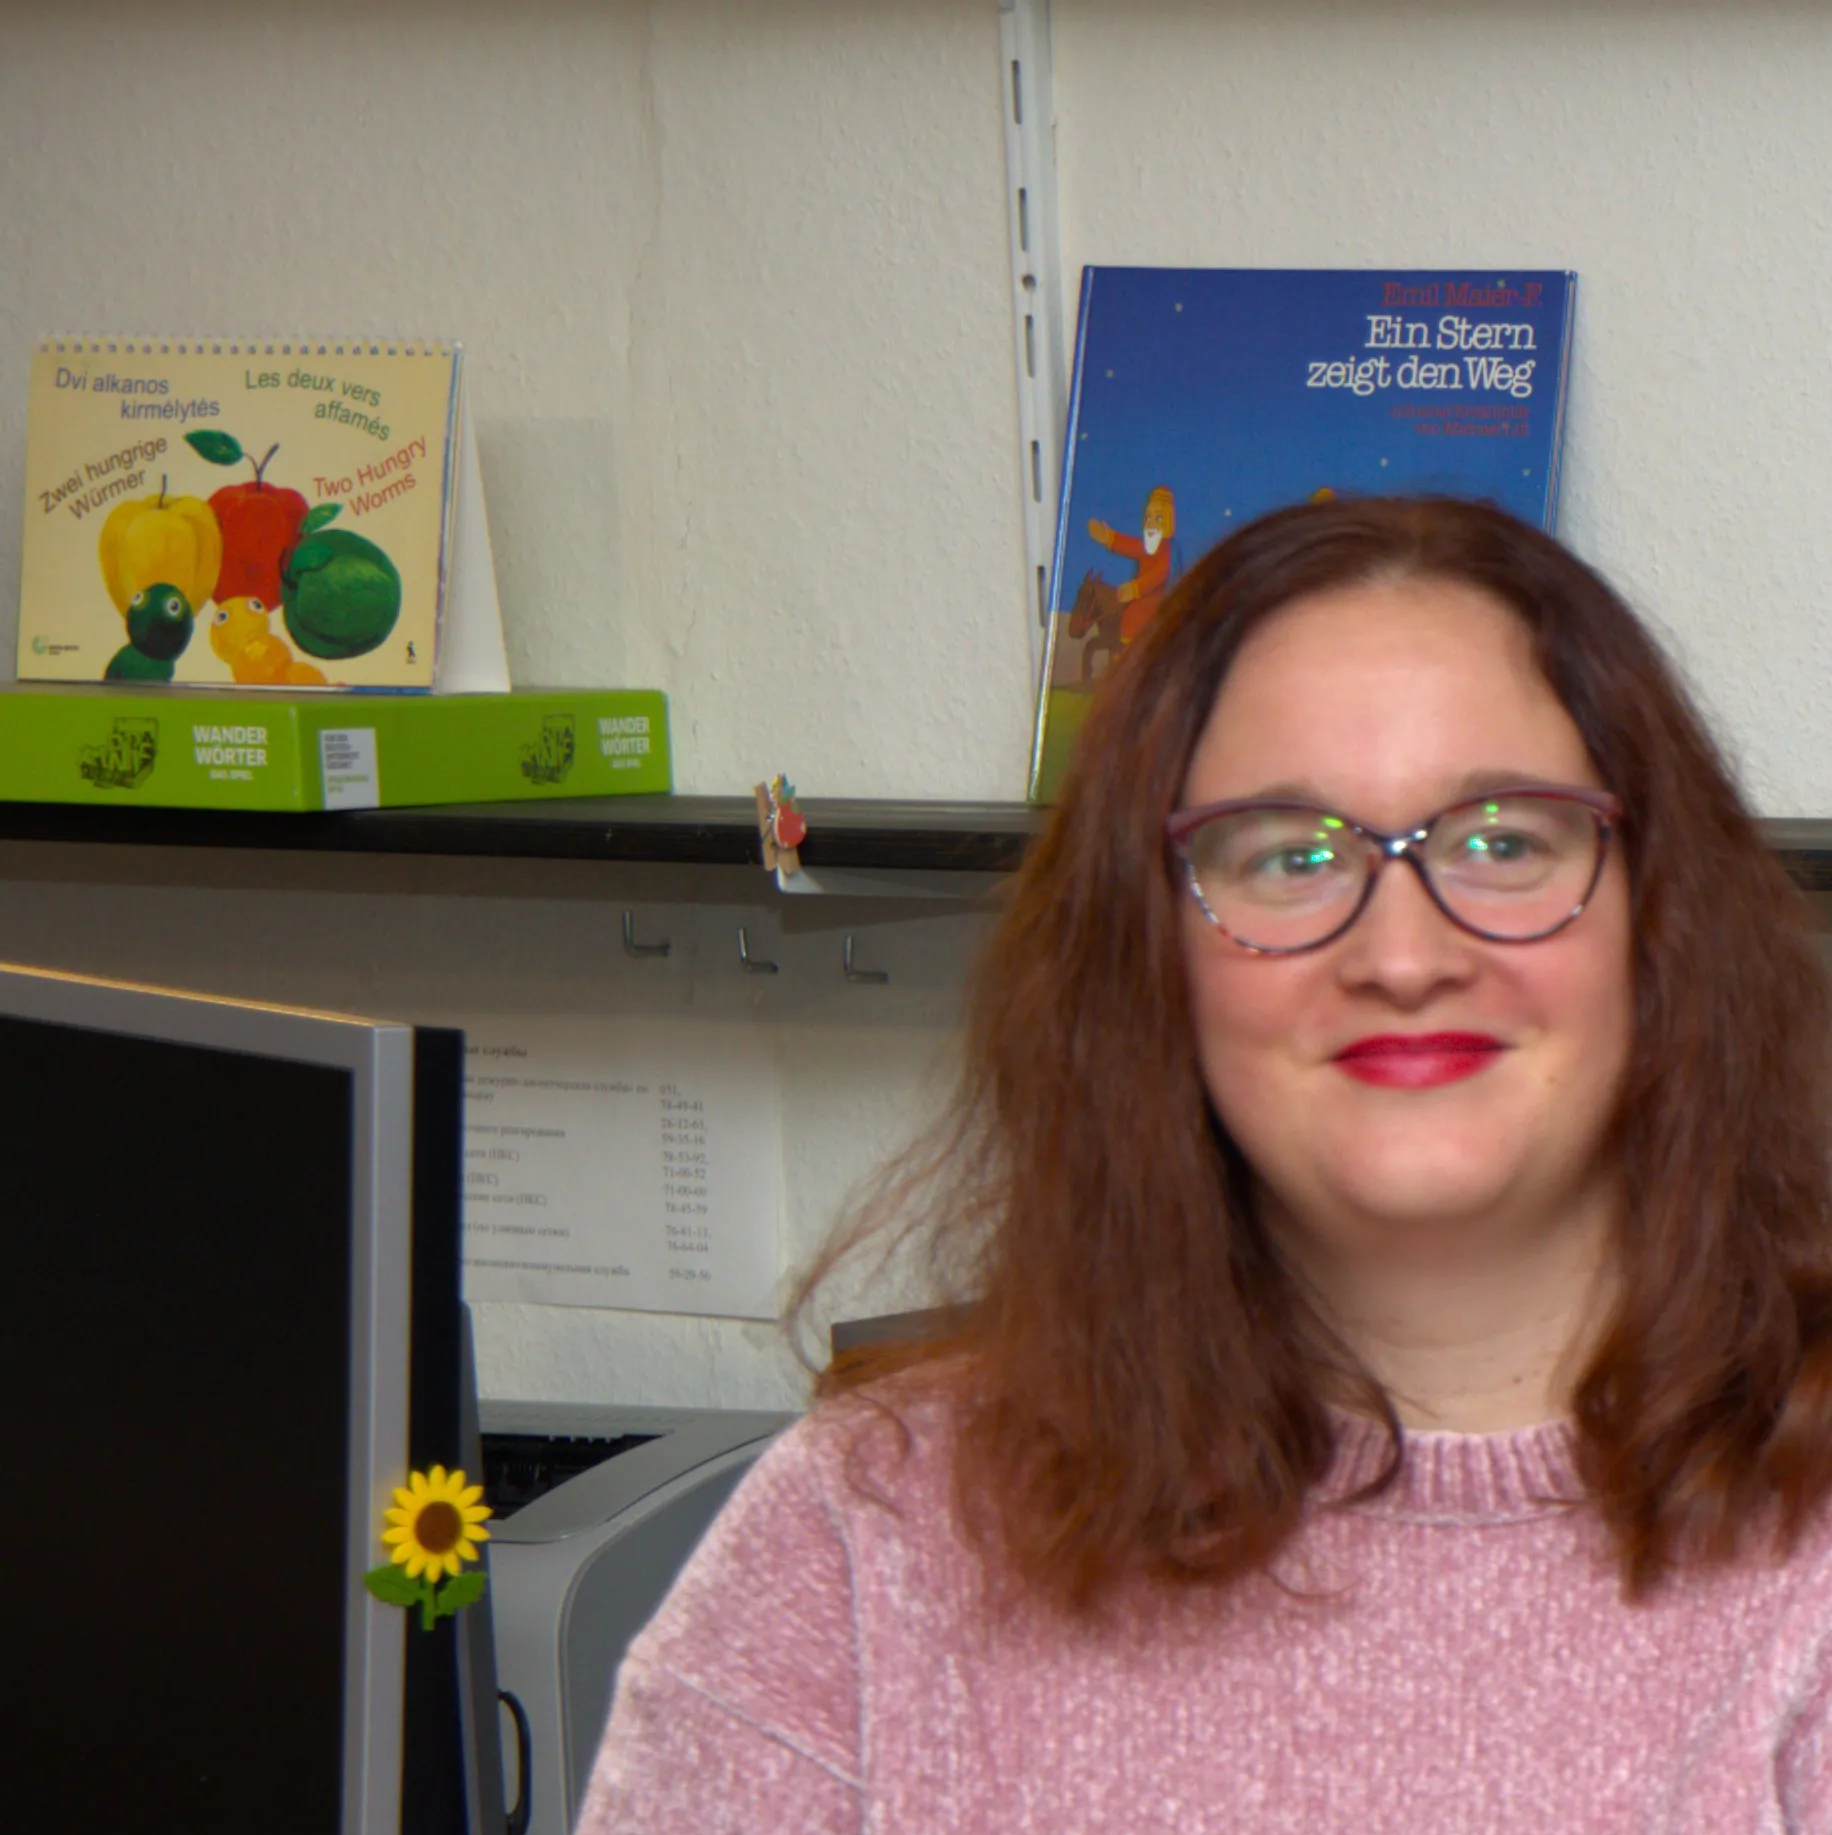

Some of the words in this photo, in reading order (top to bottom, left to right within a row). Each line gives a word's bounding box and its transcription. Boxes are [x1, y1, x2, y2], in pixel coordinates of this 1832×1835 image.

[1381, 281, 1439, 306] Emil
[1364, 315, 1431, 348] Ein
[1437, 315, 1537, 350] Stern
[56, 367, 88, 391] Dvi
[93, 373, 170, 394] alkanos
[245, 370, 281, 390] Les
[287, 368, 336, 392] deux
[342, 380, 381, 407] vers
[1306, 355, 1392, 396] zeigt
[1396, 355, 1463, 389] den
[1464, 356, 1536, 398] Weg
[314, 400, 390, 441] affamés
[39, 470, 84, 515] Zwei
[85, 437, 168, 482] hungrige
[313, 477, 353, 498] Two
[356, 435, 427, 487] Hungry
[69, 469, 146, 520] Würmer
[349, 473, 416, 517] Worms
[192, 724, 268, 745] WANDER
